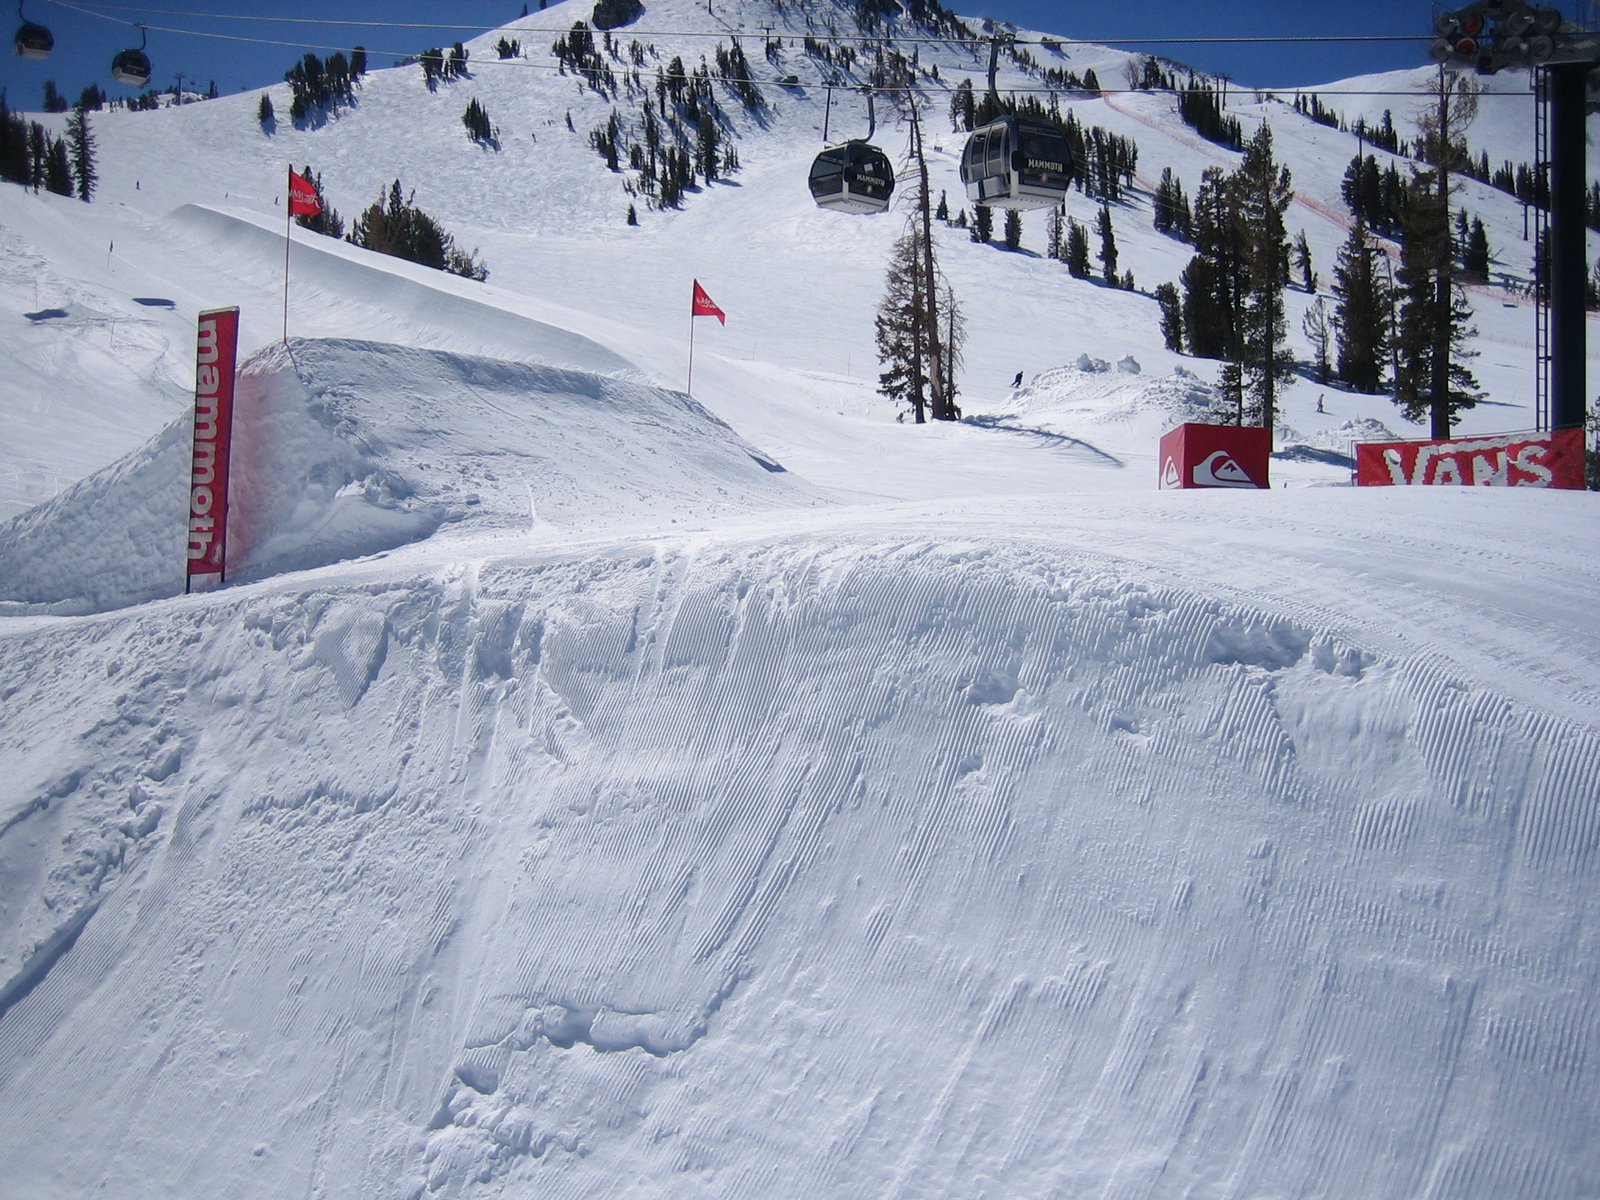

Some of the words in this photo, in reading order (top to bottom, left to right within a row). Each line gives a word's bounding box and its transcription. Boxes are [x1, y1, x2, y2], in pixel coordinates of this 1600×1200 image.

[856, 173, 886, 187] MAMMOTH
[1028, 158, 1064, 173] MAMMOTH
[188, 319, 220, 560] mammoth
[1383, 432, 1552, 487] VANS
